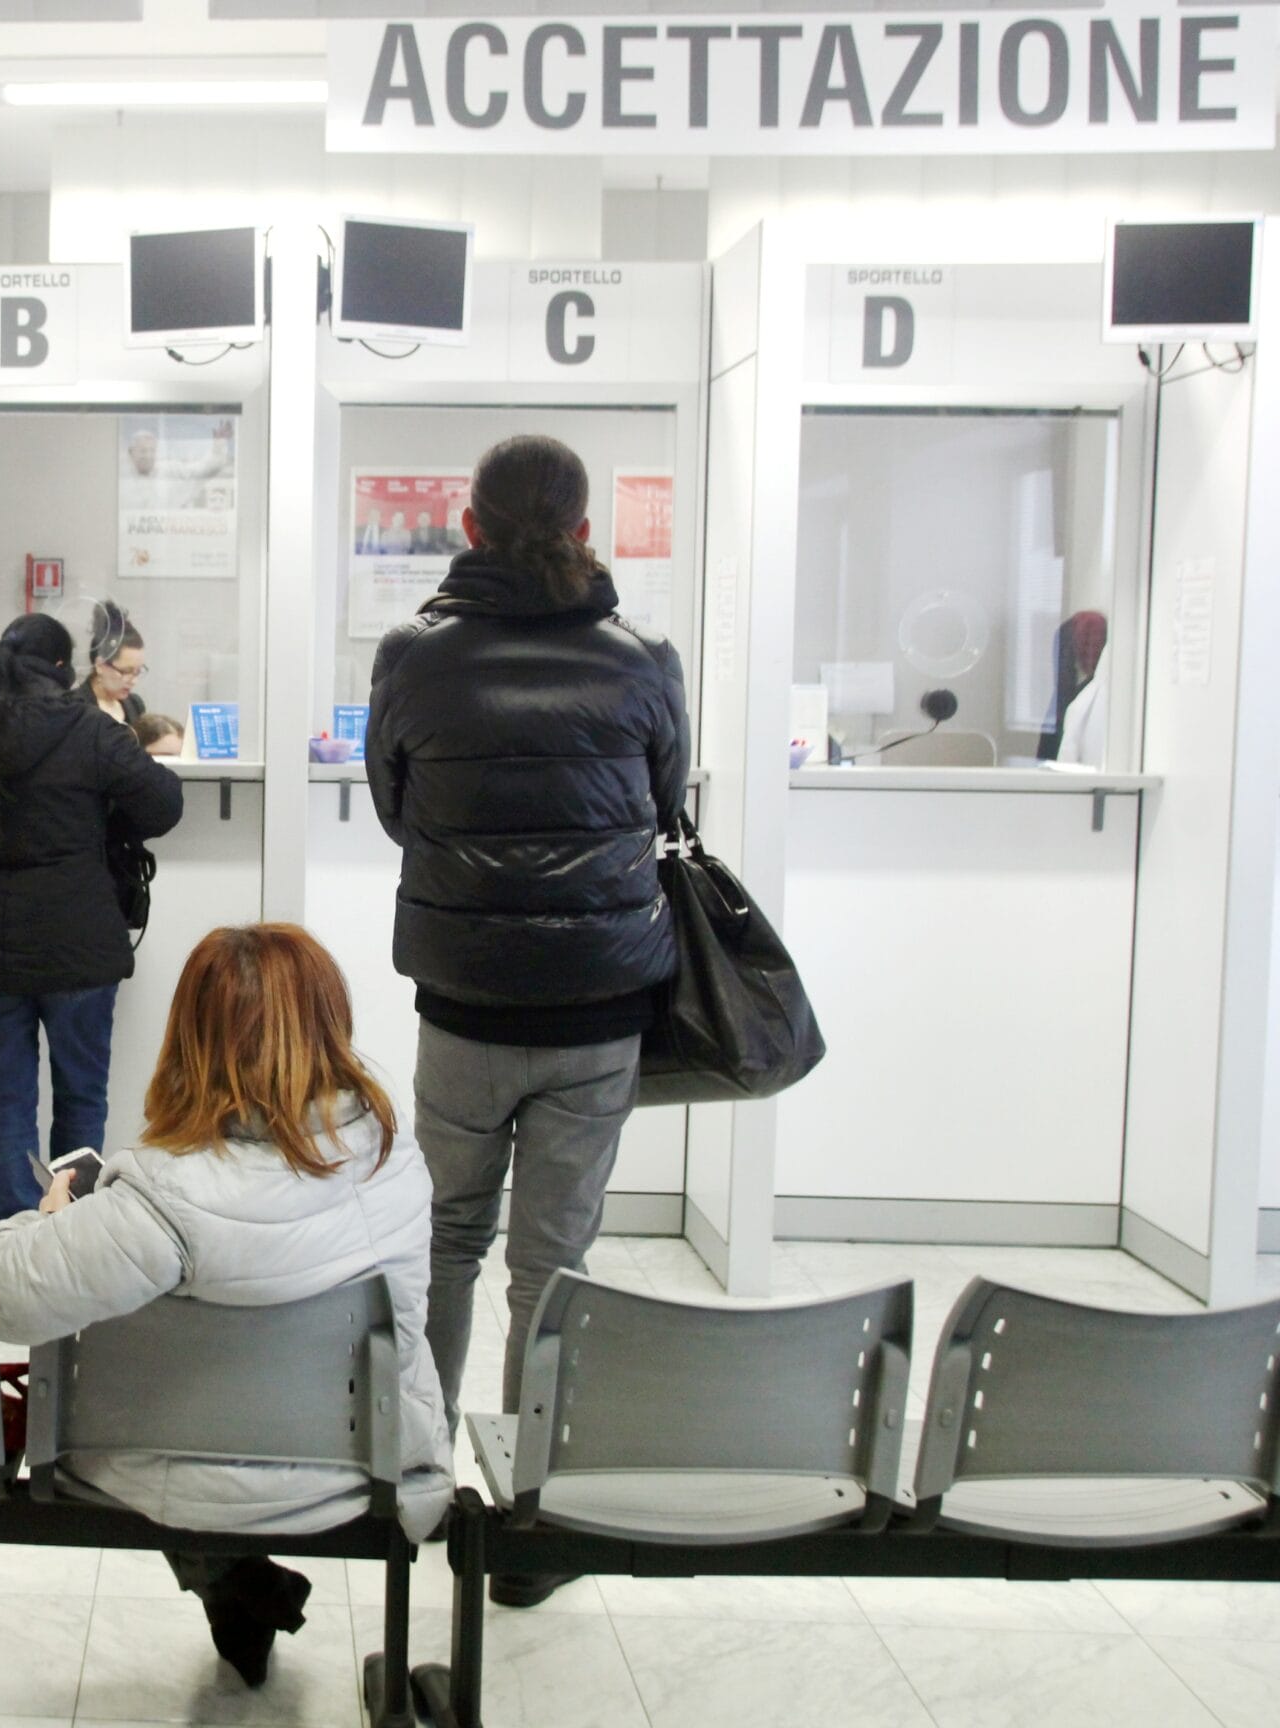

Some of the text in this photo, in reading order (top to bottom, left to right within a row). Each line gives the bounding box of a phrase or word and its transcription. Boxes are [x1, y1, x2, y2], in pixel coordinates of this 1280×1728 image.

[361, 15, 1239, 130] ACCETTAZIONE
[528, 269, 623, 285] SPORTELLO
[847, 269, 943, 285] SPORTELLO
[0, 296, 49, 369] B
[545, 290, 596, 366] C
[862, 296, 915, 369] D
